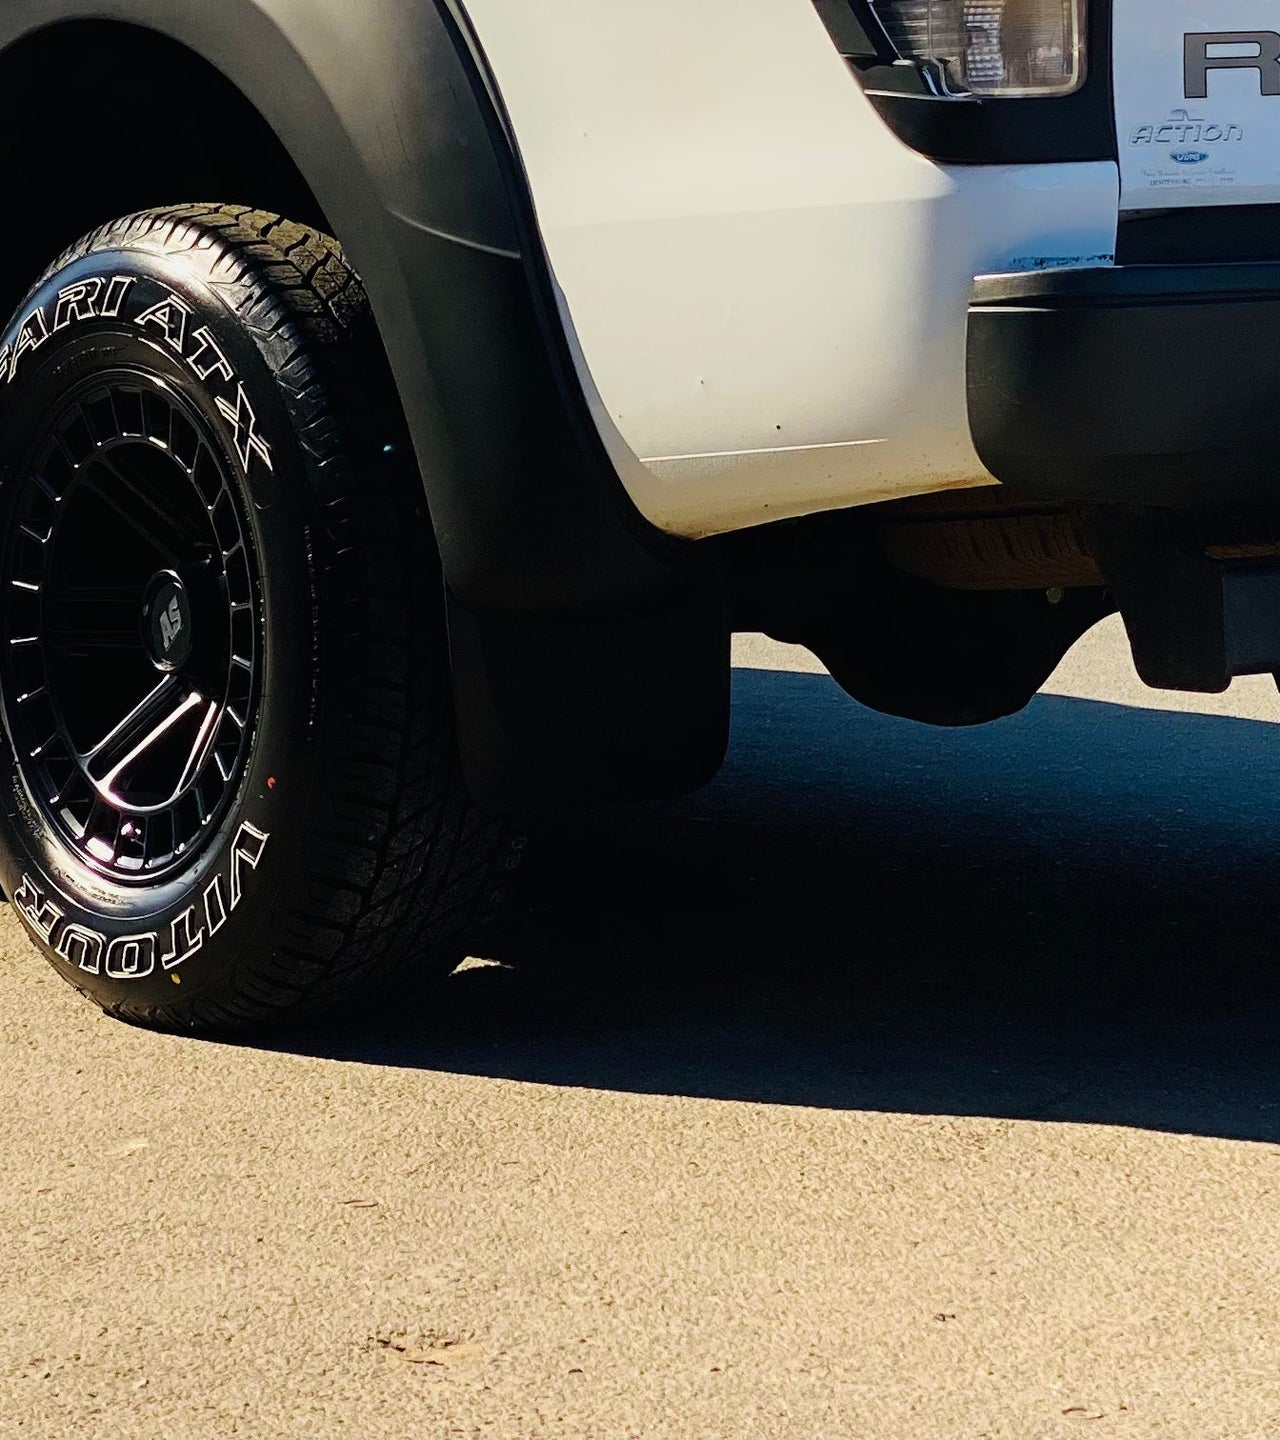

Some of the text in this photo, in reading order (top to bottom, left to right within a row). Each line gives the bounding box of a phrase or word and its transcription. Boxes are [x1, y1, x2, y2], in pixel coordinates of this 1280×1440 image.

[1129, 123, 1244, 147] ACTION
[134, 295, 276, 474] ATX
[12, 820, 271, 981] VITOUR
